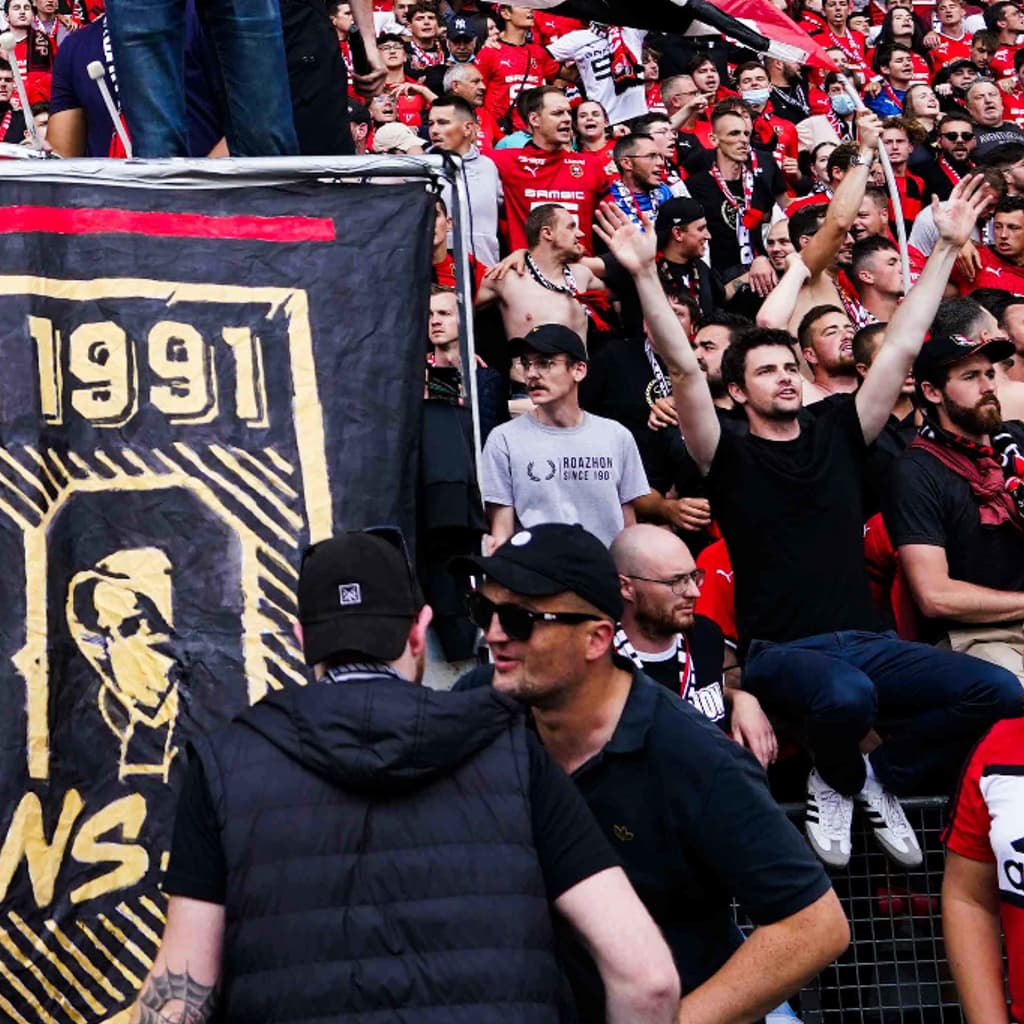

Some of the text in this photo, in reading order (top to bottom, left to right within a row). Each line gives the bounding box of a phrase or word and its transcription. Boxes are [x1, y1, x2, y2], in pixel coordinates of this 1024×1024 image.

[28, 313, 273, 431] 1991
[563, 456, 613, 468] ROAZHON
[563, 470, 589, 481] SINCE
